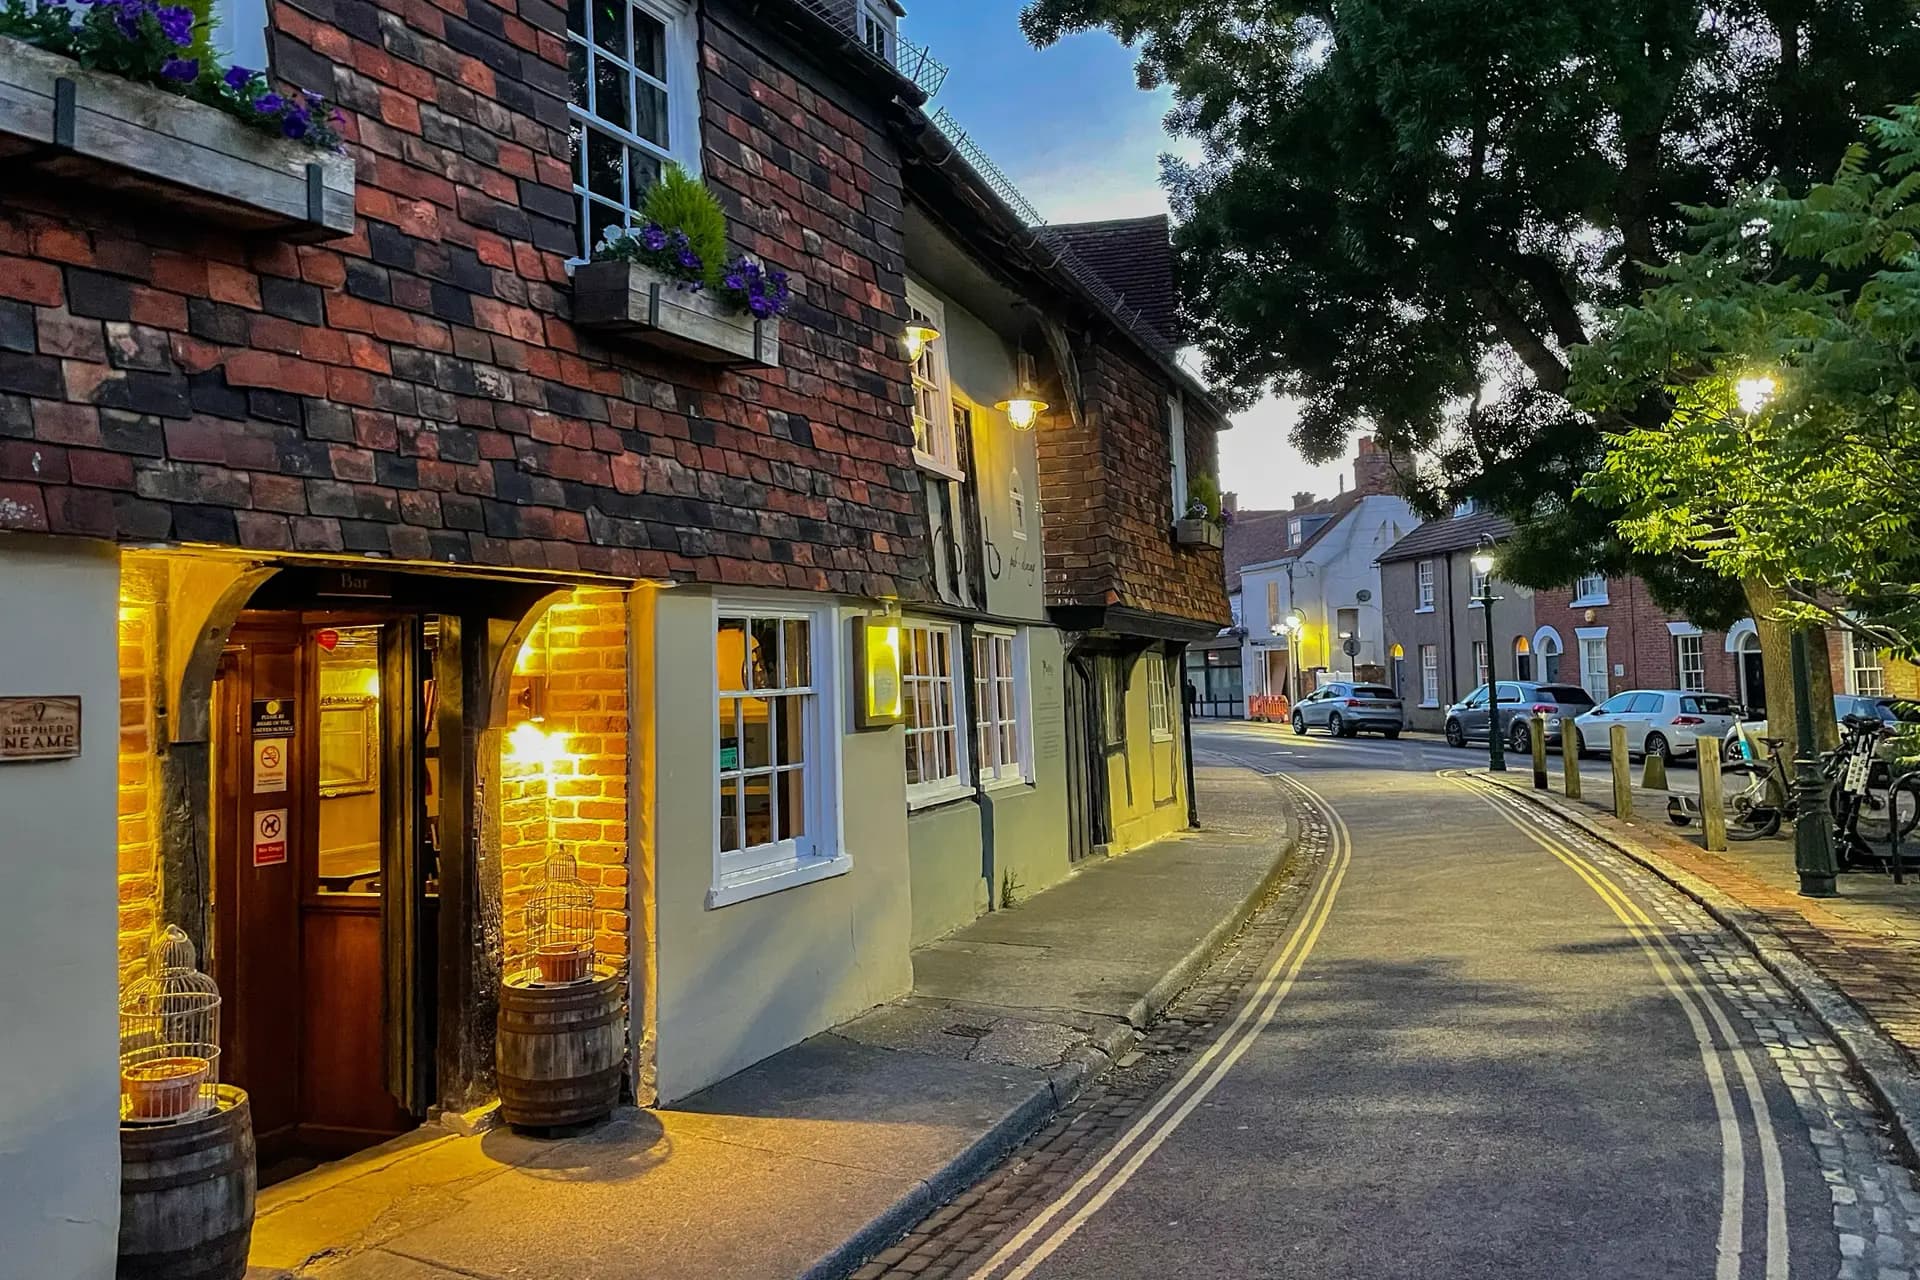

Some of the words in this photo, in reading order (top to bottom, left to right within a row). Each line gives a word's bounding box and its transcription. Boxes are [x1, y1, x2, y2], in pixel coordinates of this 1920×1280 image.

[341, 573, 369, 589] Bar
[4, 724, 74, 736] SHEPHERD
[4, 734, 74, 750] NEAME
